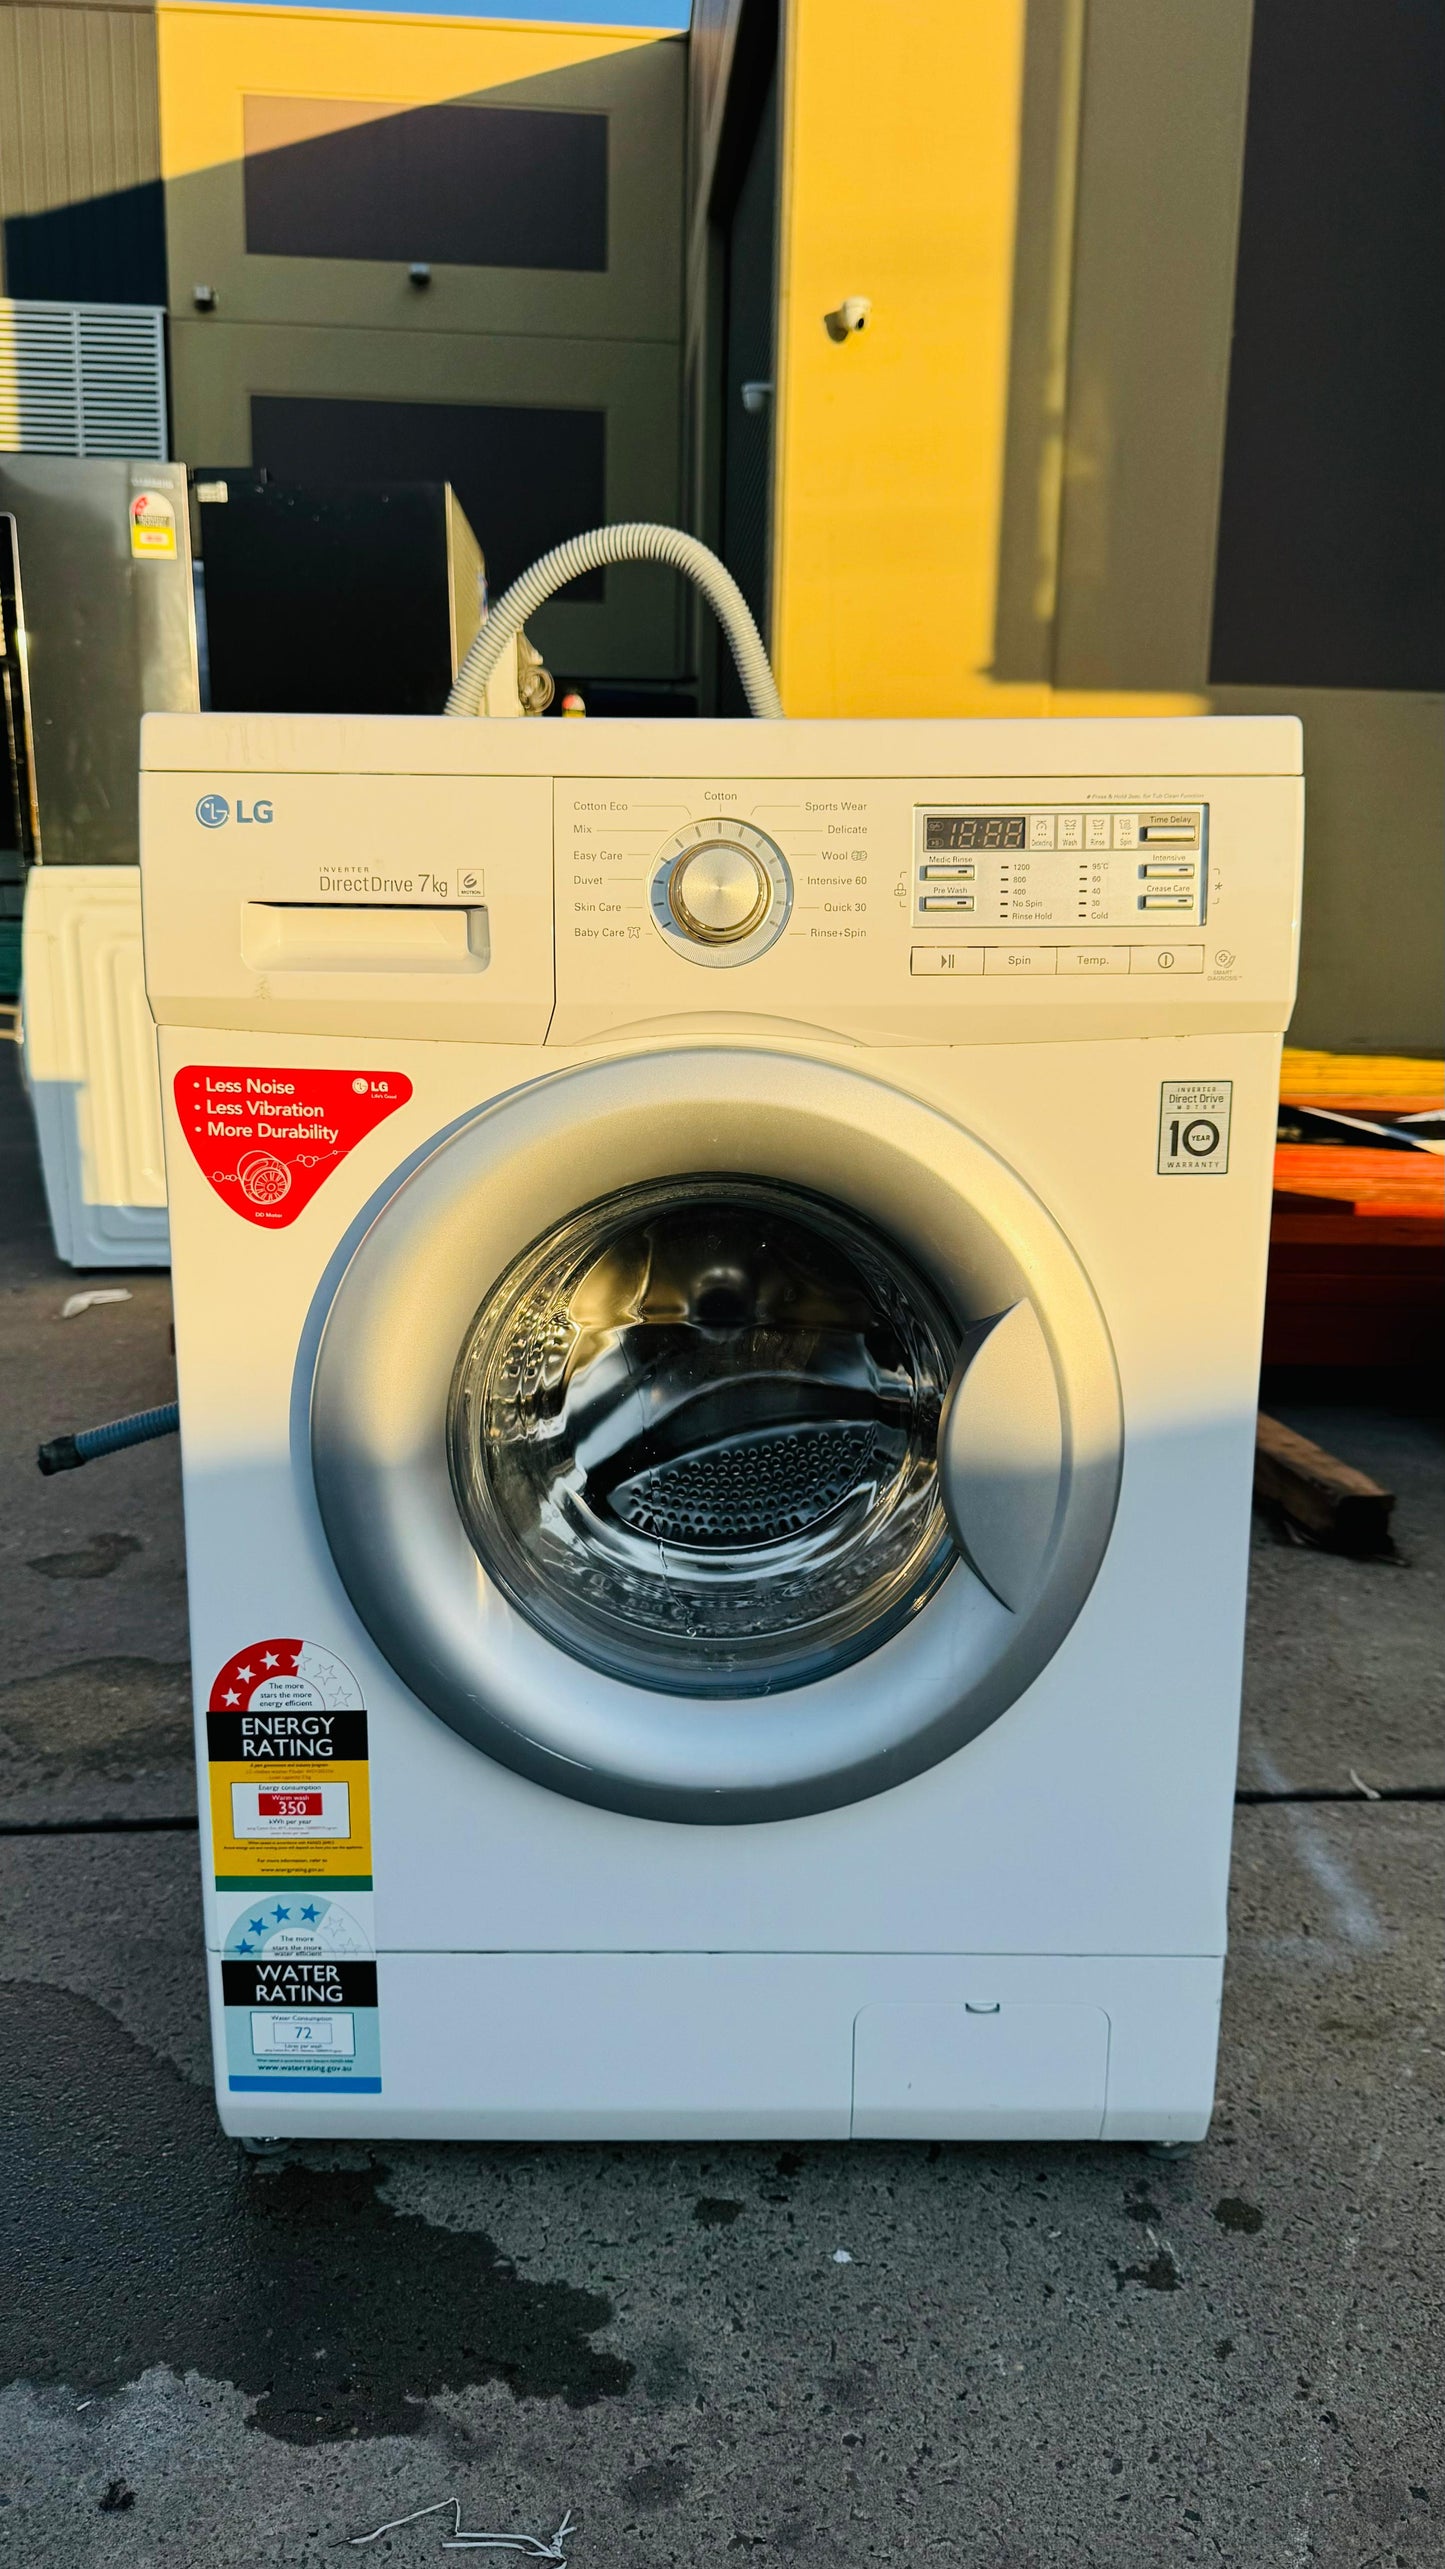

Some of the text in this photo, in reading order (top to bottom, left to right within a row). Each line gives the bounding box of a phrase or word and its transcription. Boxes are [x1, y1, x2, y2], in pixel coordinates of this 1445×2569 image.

[704, 791, 738, 801] Cotton
[236, 799, 274, 824] LG
[573, 801, 629, 812] Cotton Eco
[805, 801, 867, 813] Sports Wear
[1150, 816, 1192, 824] Time Delay
[573, 824, 592, 834] Mix
[827, 823, 868, 835] Delicate
[573, 850, 623, 863] Easy Care
[821, 850, 848, 861] Wool
[1152, 853, 1186, 862] Intensive
[319, 866, 370, 874] INVERTER
[1013, 863, 1031, 871] 1200
[573, 874, 603, 885] Duvet
[807, 874, 867, 885] Intensive 60
[1013, 875, 1027, 884] 800
[1092, 875, 1102, 883] 60
[933, 886, 968, 894] Pre Wash
[1012, 888, 1027, 896] 400
[1091, 887, 1101, 895] 40
[1173, 885, 1190, 893] Care
[574, 902, 622, 912] Skin Care
[824, 902, 867, 913] Quick 30
[1012, 899, 1043, 909] No Spin
[1091, 899, 1101, 907] 30
[1012, 912, 1053, 920] Rinse Hold
[1091, 912, 1109, 920] Cold
[574, 927, 625, 940] Baby Care
[810, 927, 867, 939] Rinse+Spin
[1008, 954, 1032, 967] Spin
[1077, 955, 1110, 967] Temp.
[205, 1077, 295, 1095] Less Noise
[370, 1081, 389, 1093] LG
[1169, 1093, 1224, 1103] Direct Drive
[206, 1099, 324, 1118] Less Vibration
[207, 1121, 339, 1144] More Durability
[1169, 1119, 1220, 1157] 10
[269, 1682, 284, 1690] The
[259, 1700, 283, 1708] energy
[241, 1716, 336, 1735] ENERGY
[242, 1738, 334, 1757] RATING
[258, 1784, 322, 1792] Energy consumption
[278, 1801, 307, 1815] 350
[280, 1935, 294, 1943] The
[256, 1965, 340, 1982] WATER
[256, 1985, 343, 2002] RATING
[294, 2026, 312, 2039] 72
